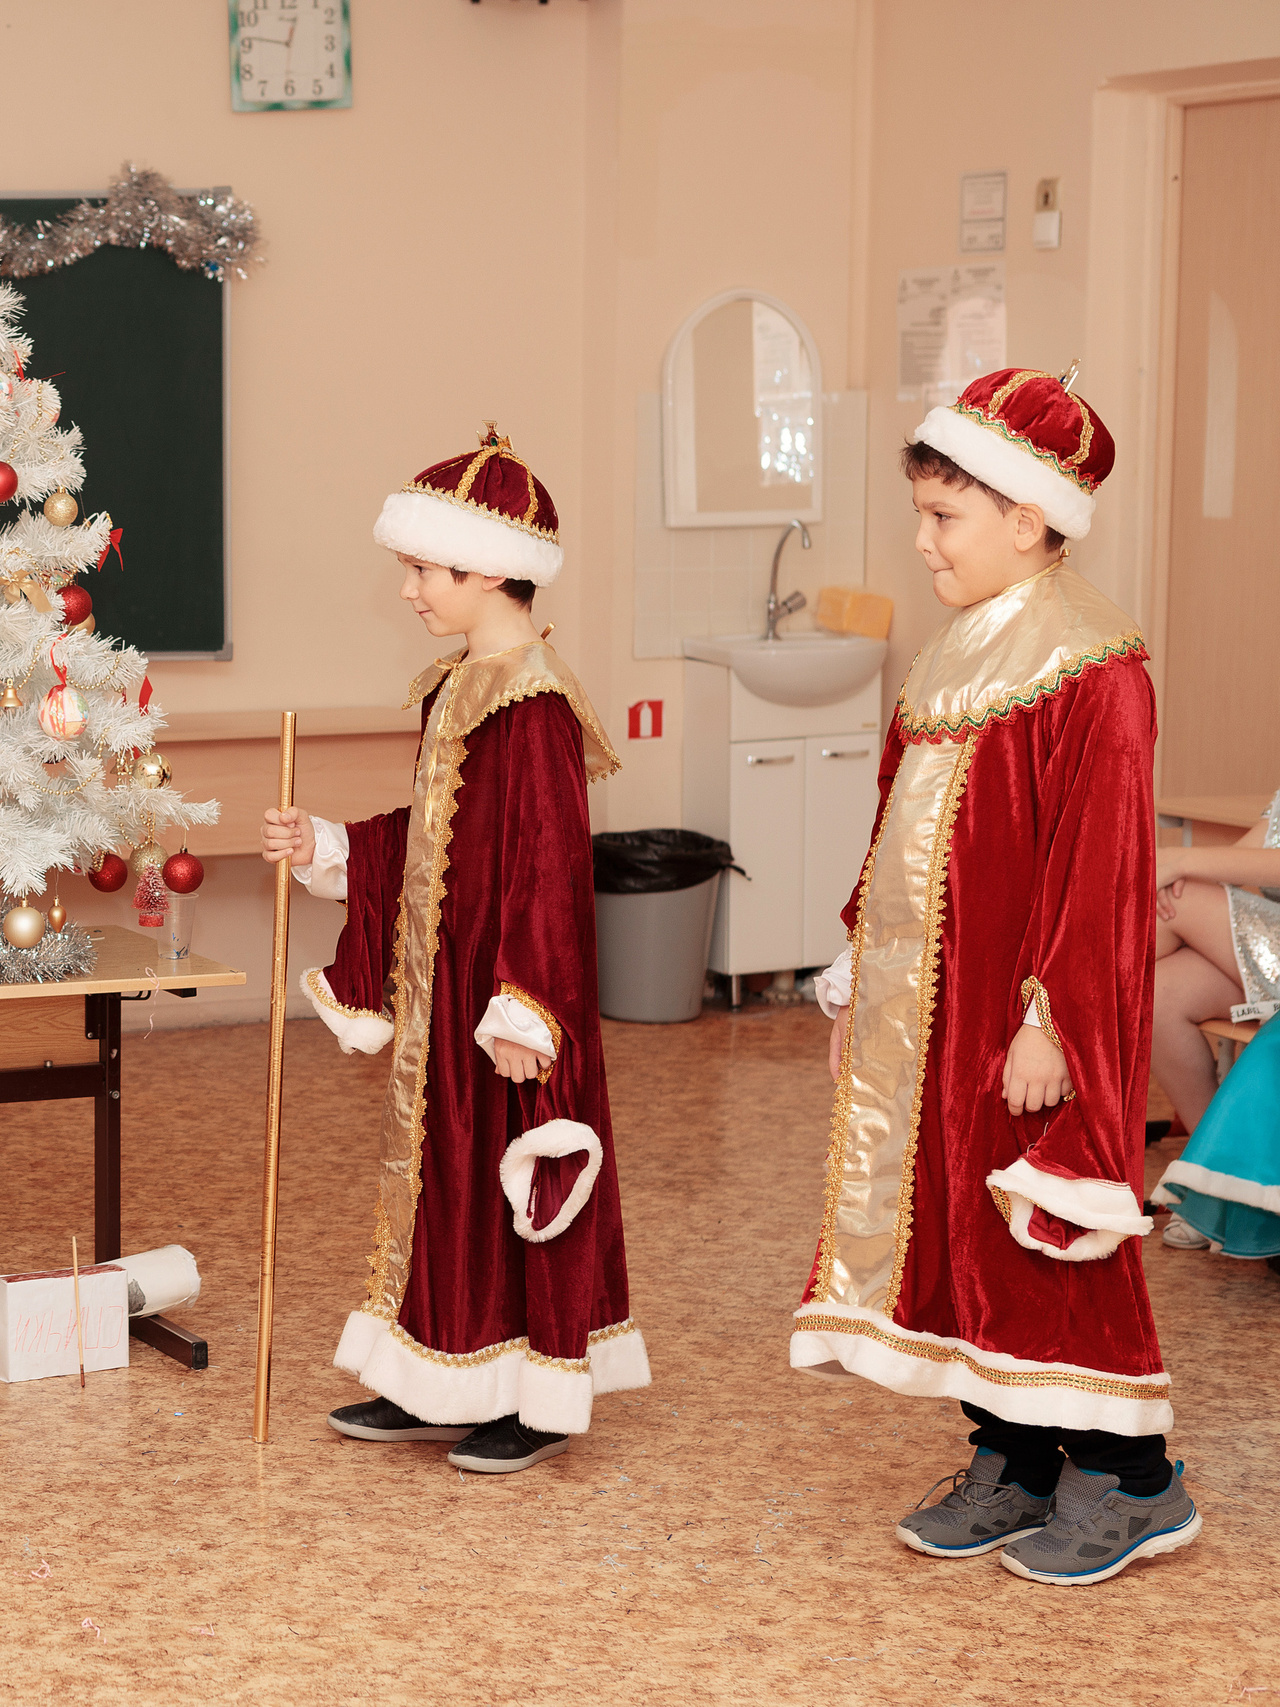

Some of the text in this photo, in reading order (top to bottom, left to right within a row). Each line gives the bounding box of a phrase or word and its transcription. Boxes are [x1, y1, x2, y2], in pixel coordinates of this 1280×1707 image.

[324, 34, 335, 52] 3
[240, 64, 253, 81] 8
[284, 79, 295, 96] 6
[312, 79, 323, 96] 5
